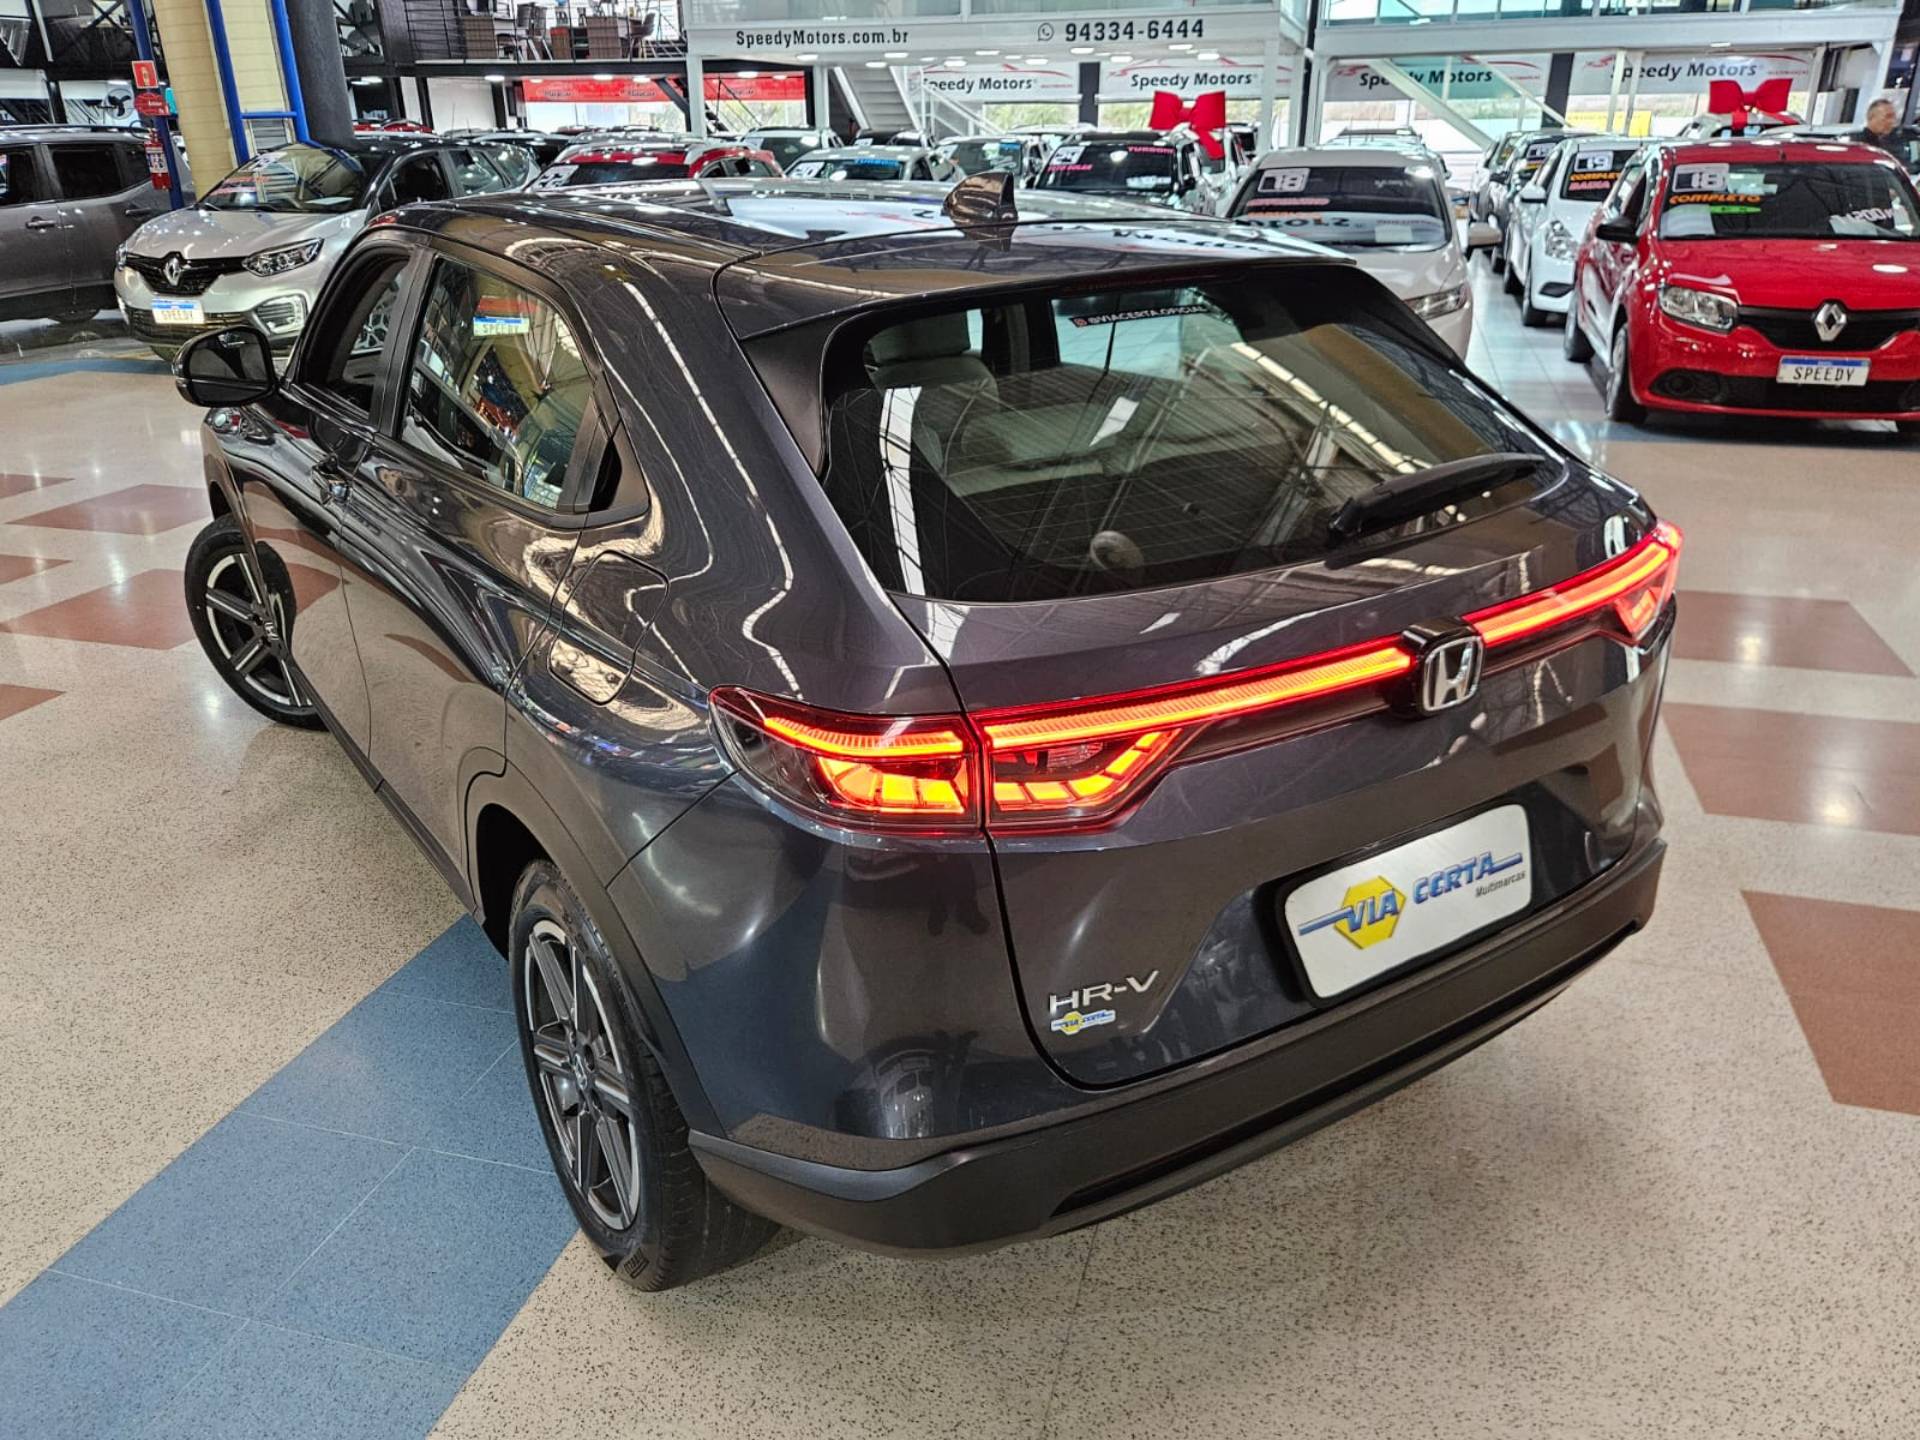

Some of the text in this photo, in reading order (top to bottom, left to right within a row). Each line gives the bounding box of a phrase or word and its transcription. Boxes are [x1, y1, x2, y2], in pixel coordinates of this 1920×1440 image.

[736, 29, 909, 48] SpeedyMotors.com.br
[1065, 19, 1205, 42] 94334-6444
[1131, 72, 1252, 91] Speedy Motors
[1360, 69, 1493, 90] Spey Motors
[1610, 62, 1758, 82] peedy Motors
[979, 77, 1033, 91] Motors
[1669, 193, 1761, 205] COMPLETO
[1793, 366, 1856, 382] SPEEDY
[1347, 850, 1496, 933] VIA CERTA
[1475, 870, 1527, 899] Multimarcas
[1050, 970, 1160, 1017] HR-V
